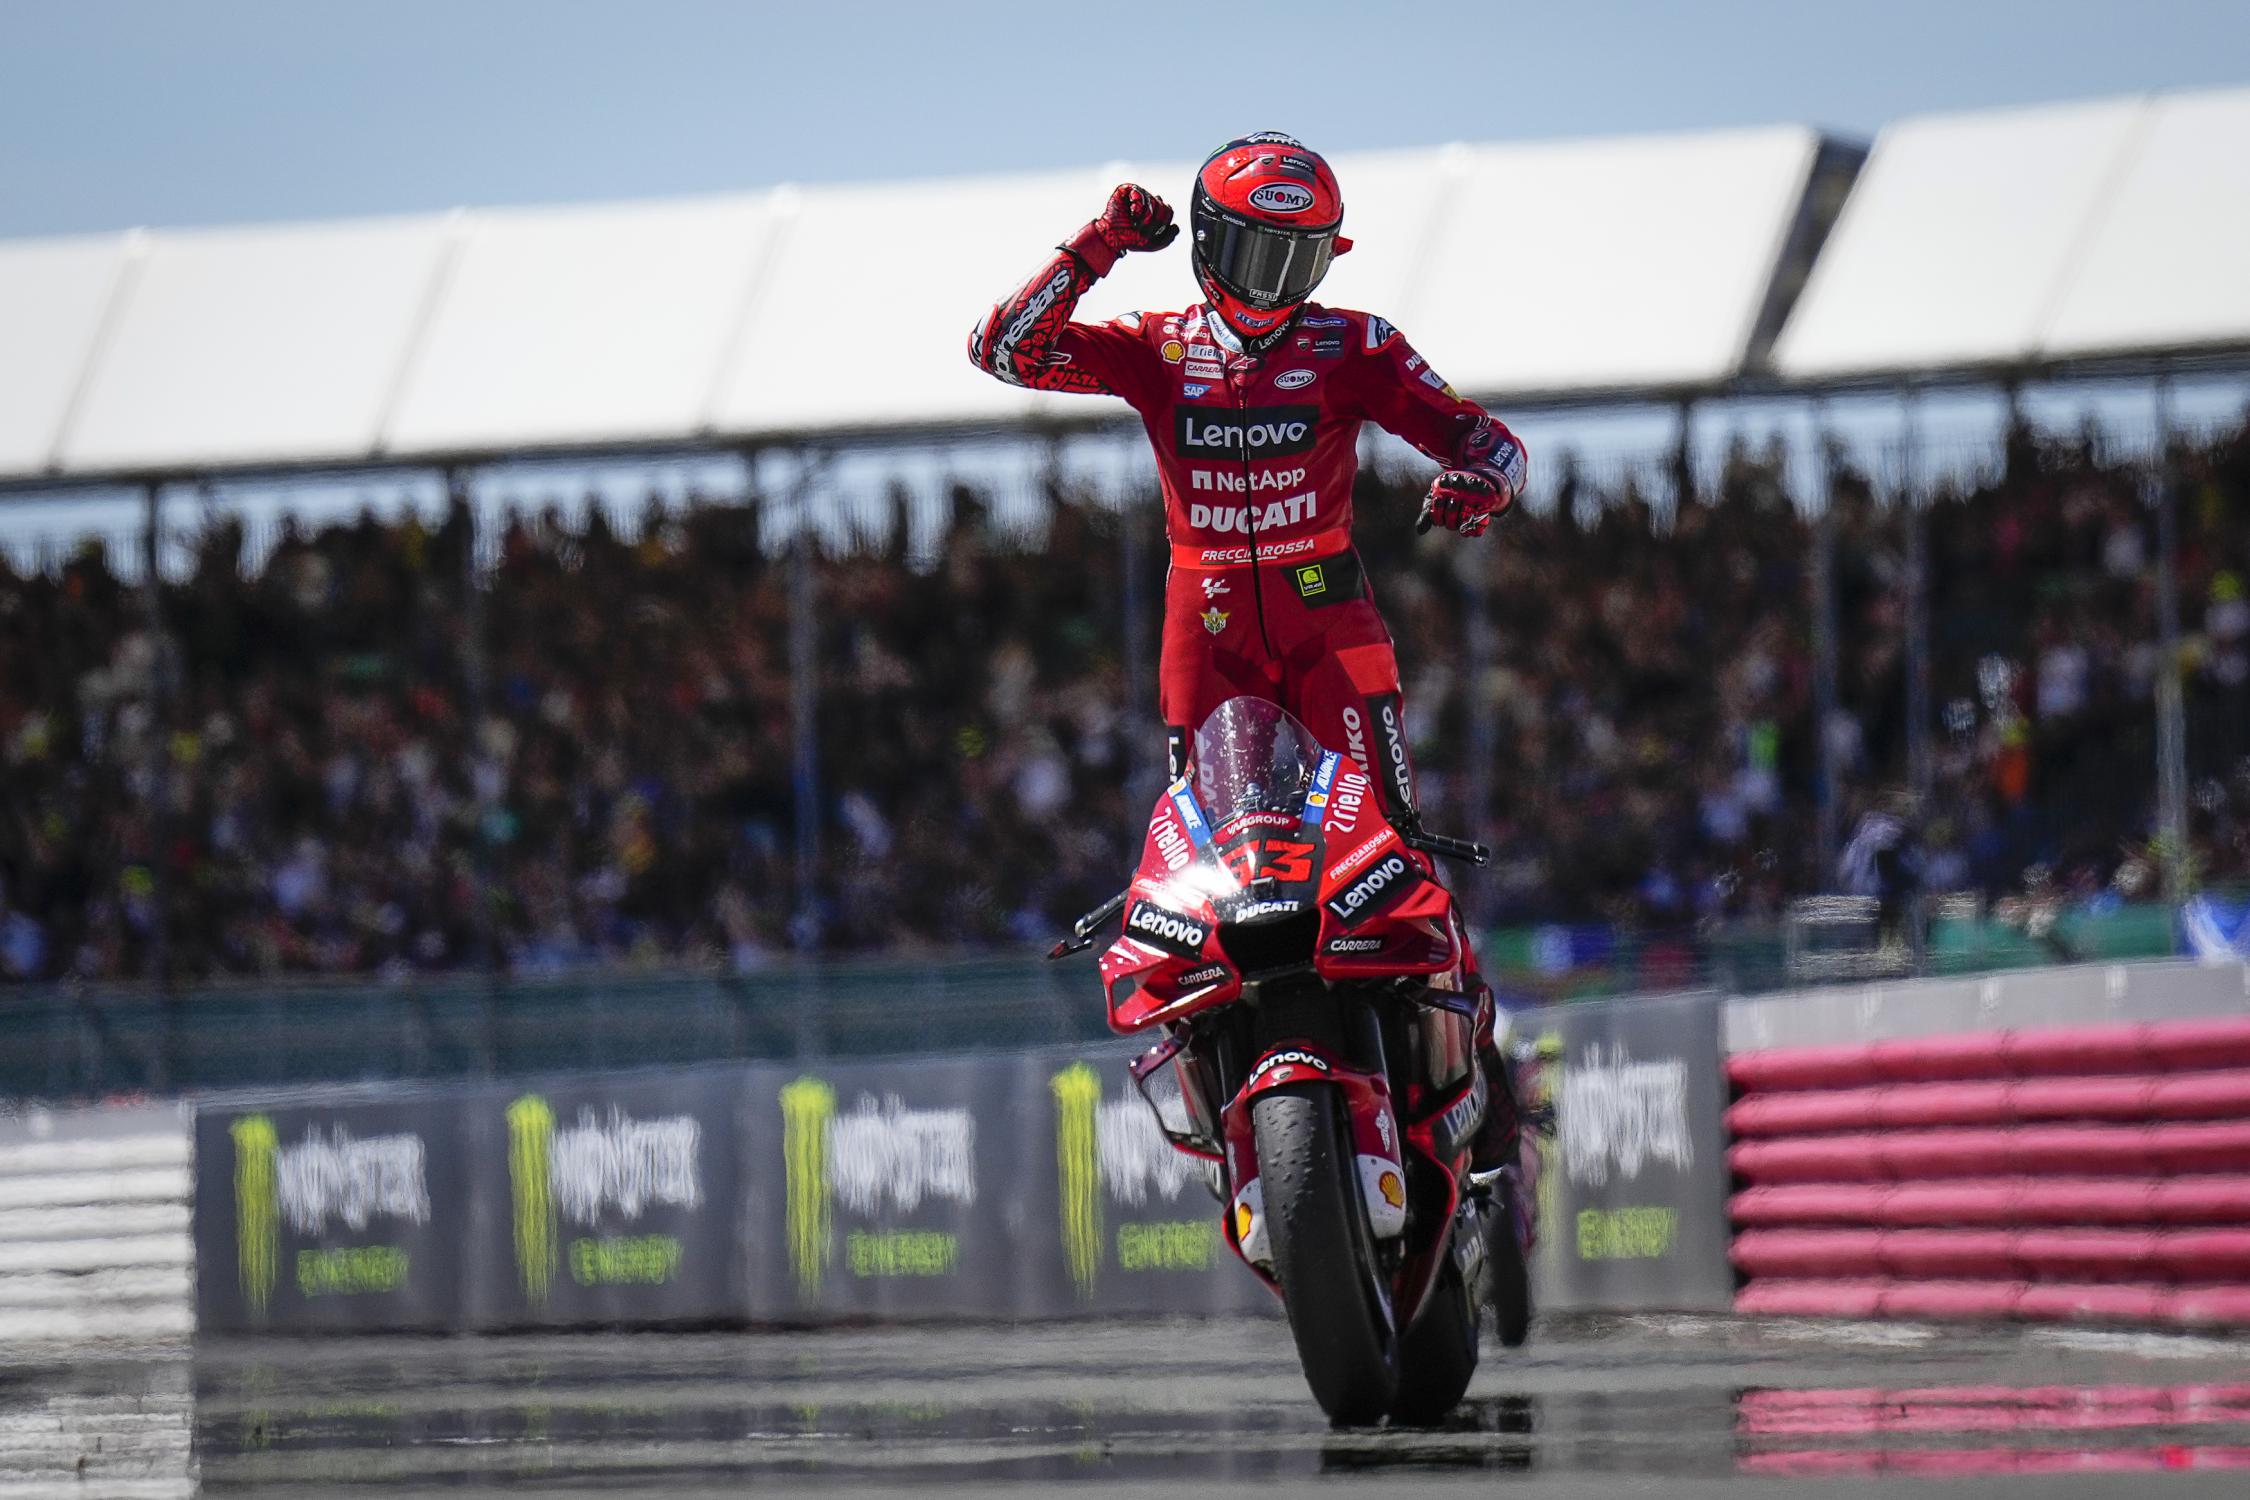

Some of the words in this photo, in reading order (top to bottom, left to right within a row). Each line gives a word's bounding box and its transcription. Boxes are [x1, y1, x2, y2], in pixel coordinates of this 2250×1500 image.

[1256, 188, 1309, 207] SUOMY
[1184, 385, 1205, 398] SAP
[1279, 374, 1313, 384] SUOMY
[1186, 417, 1308, 448] Lenovo
[1217, 467, 1306, 492] NetApp
[1190, 491, 1317, 534] DUCATI
[1382, 705, 1412, 811] enovo
[1330, 829, 1394, 880] FRECCIAROSSA
[1329, 857, 1405, 918] Lenovo
[1129, 903, 1203, 947] Lenovo
[1235, 900, 1299, 922] DUCATI
[1331, 939, 1381, 952] CARRERA
[1249, 1052, 1328, 1086] Lenovo
